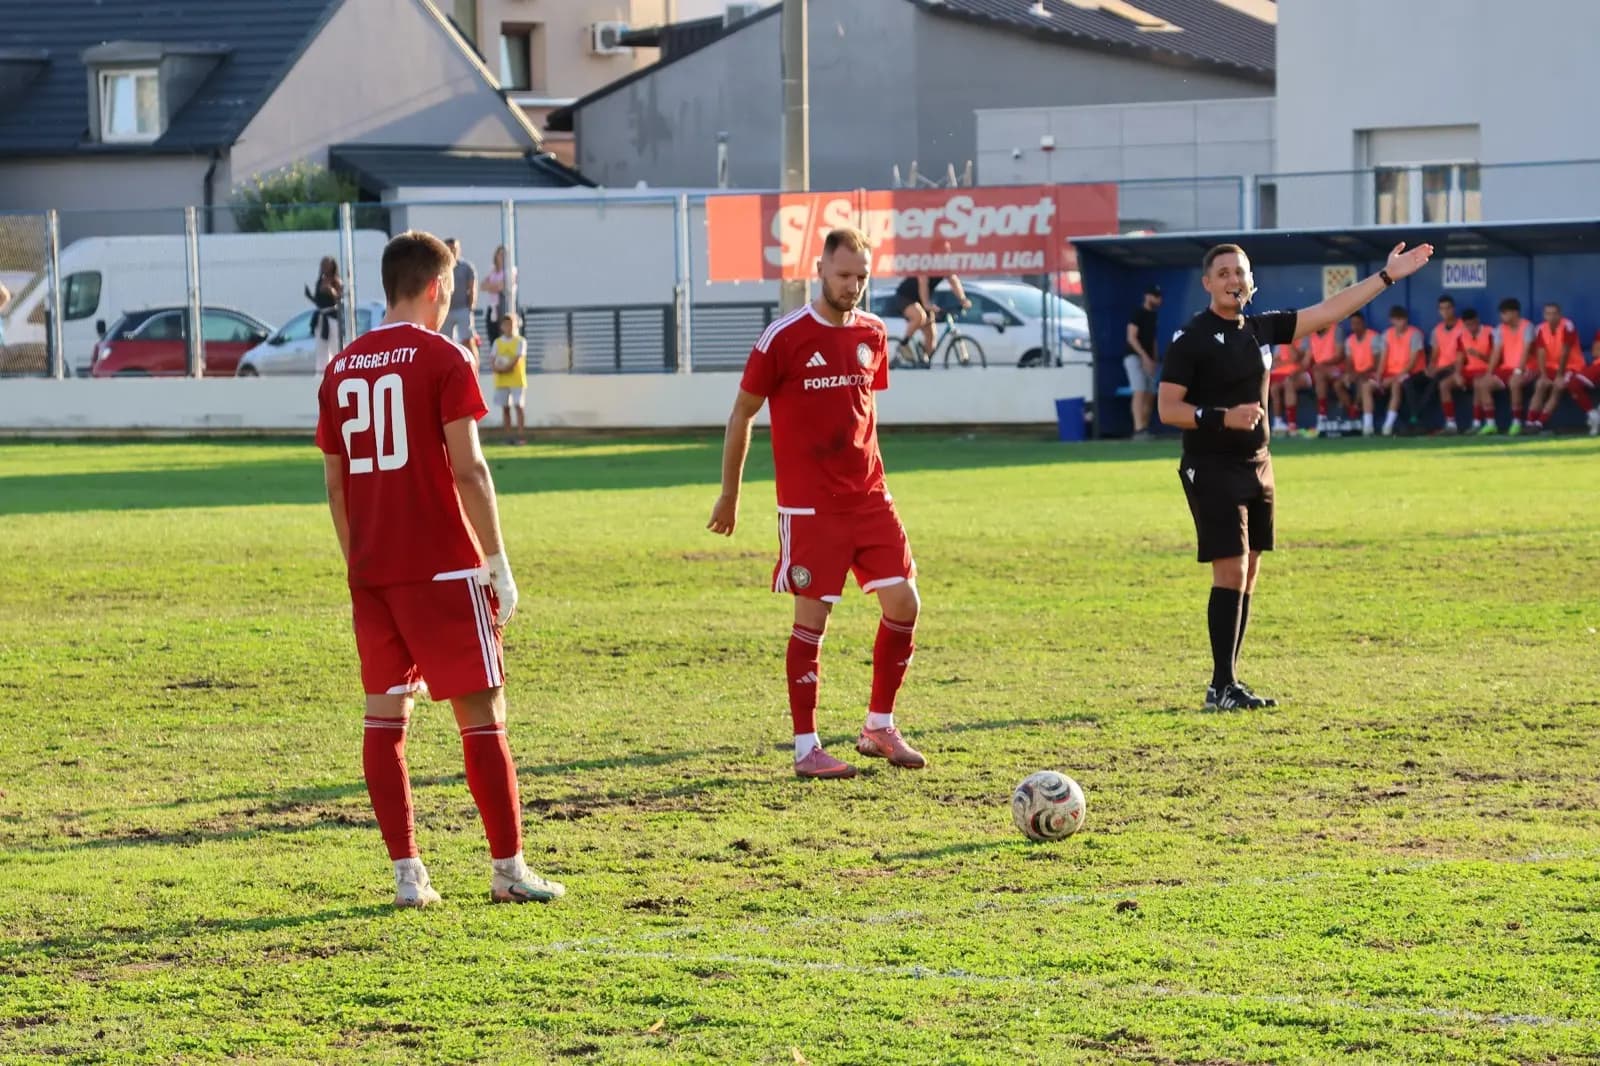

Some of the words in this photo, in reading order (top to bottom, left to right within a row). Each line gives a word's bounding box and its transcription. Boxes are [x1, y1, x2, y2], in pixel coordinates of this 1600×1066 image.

[818, 195, 1056, 248] SuperSport
[876, 251, 996, 273] NOGOMETNA
[1002, 250, 1045, 270] LIGA
[333, 356, 347, 374] NK
[348, 351, 390, 369] ZAGREB
[391, 347, 418, 364] CITY
[337, 373, 409, 474] 20
